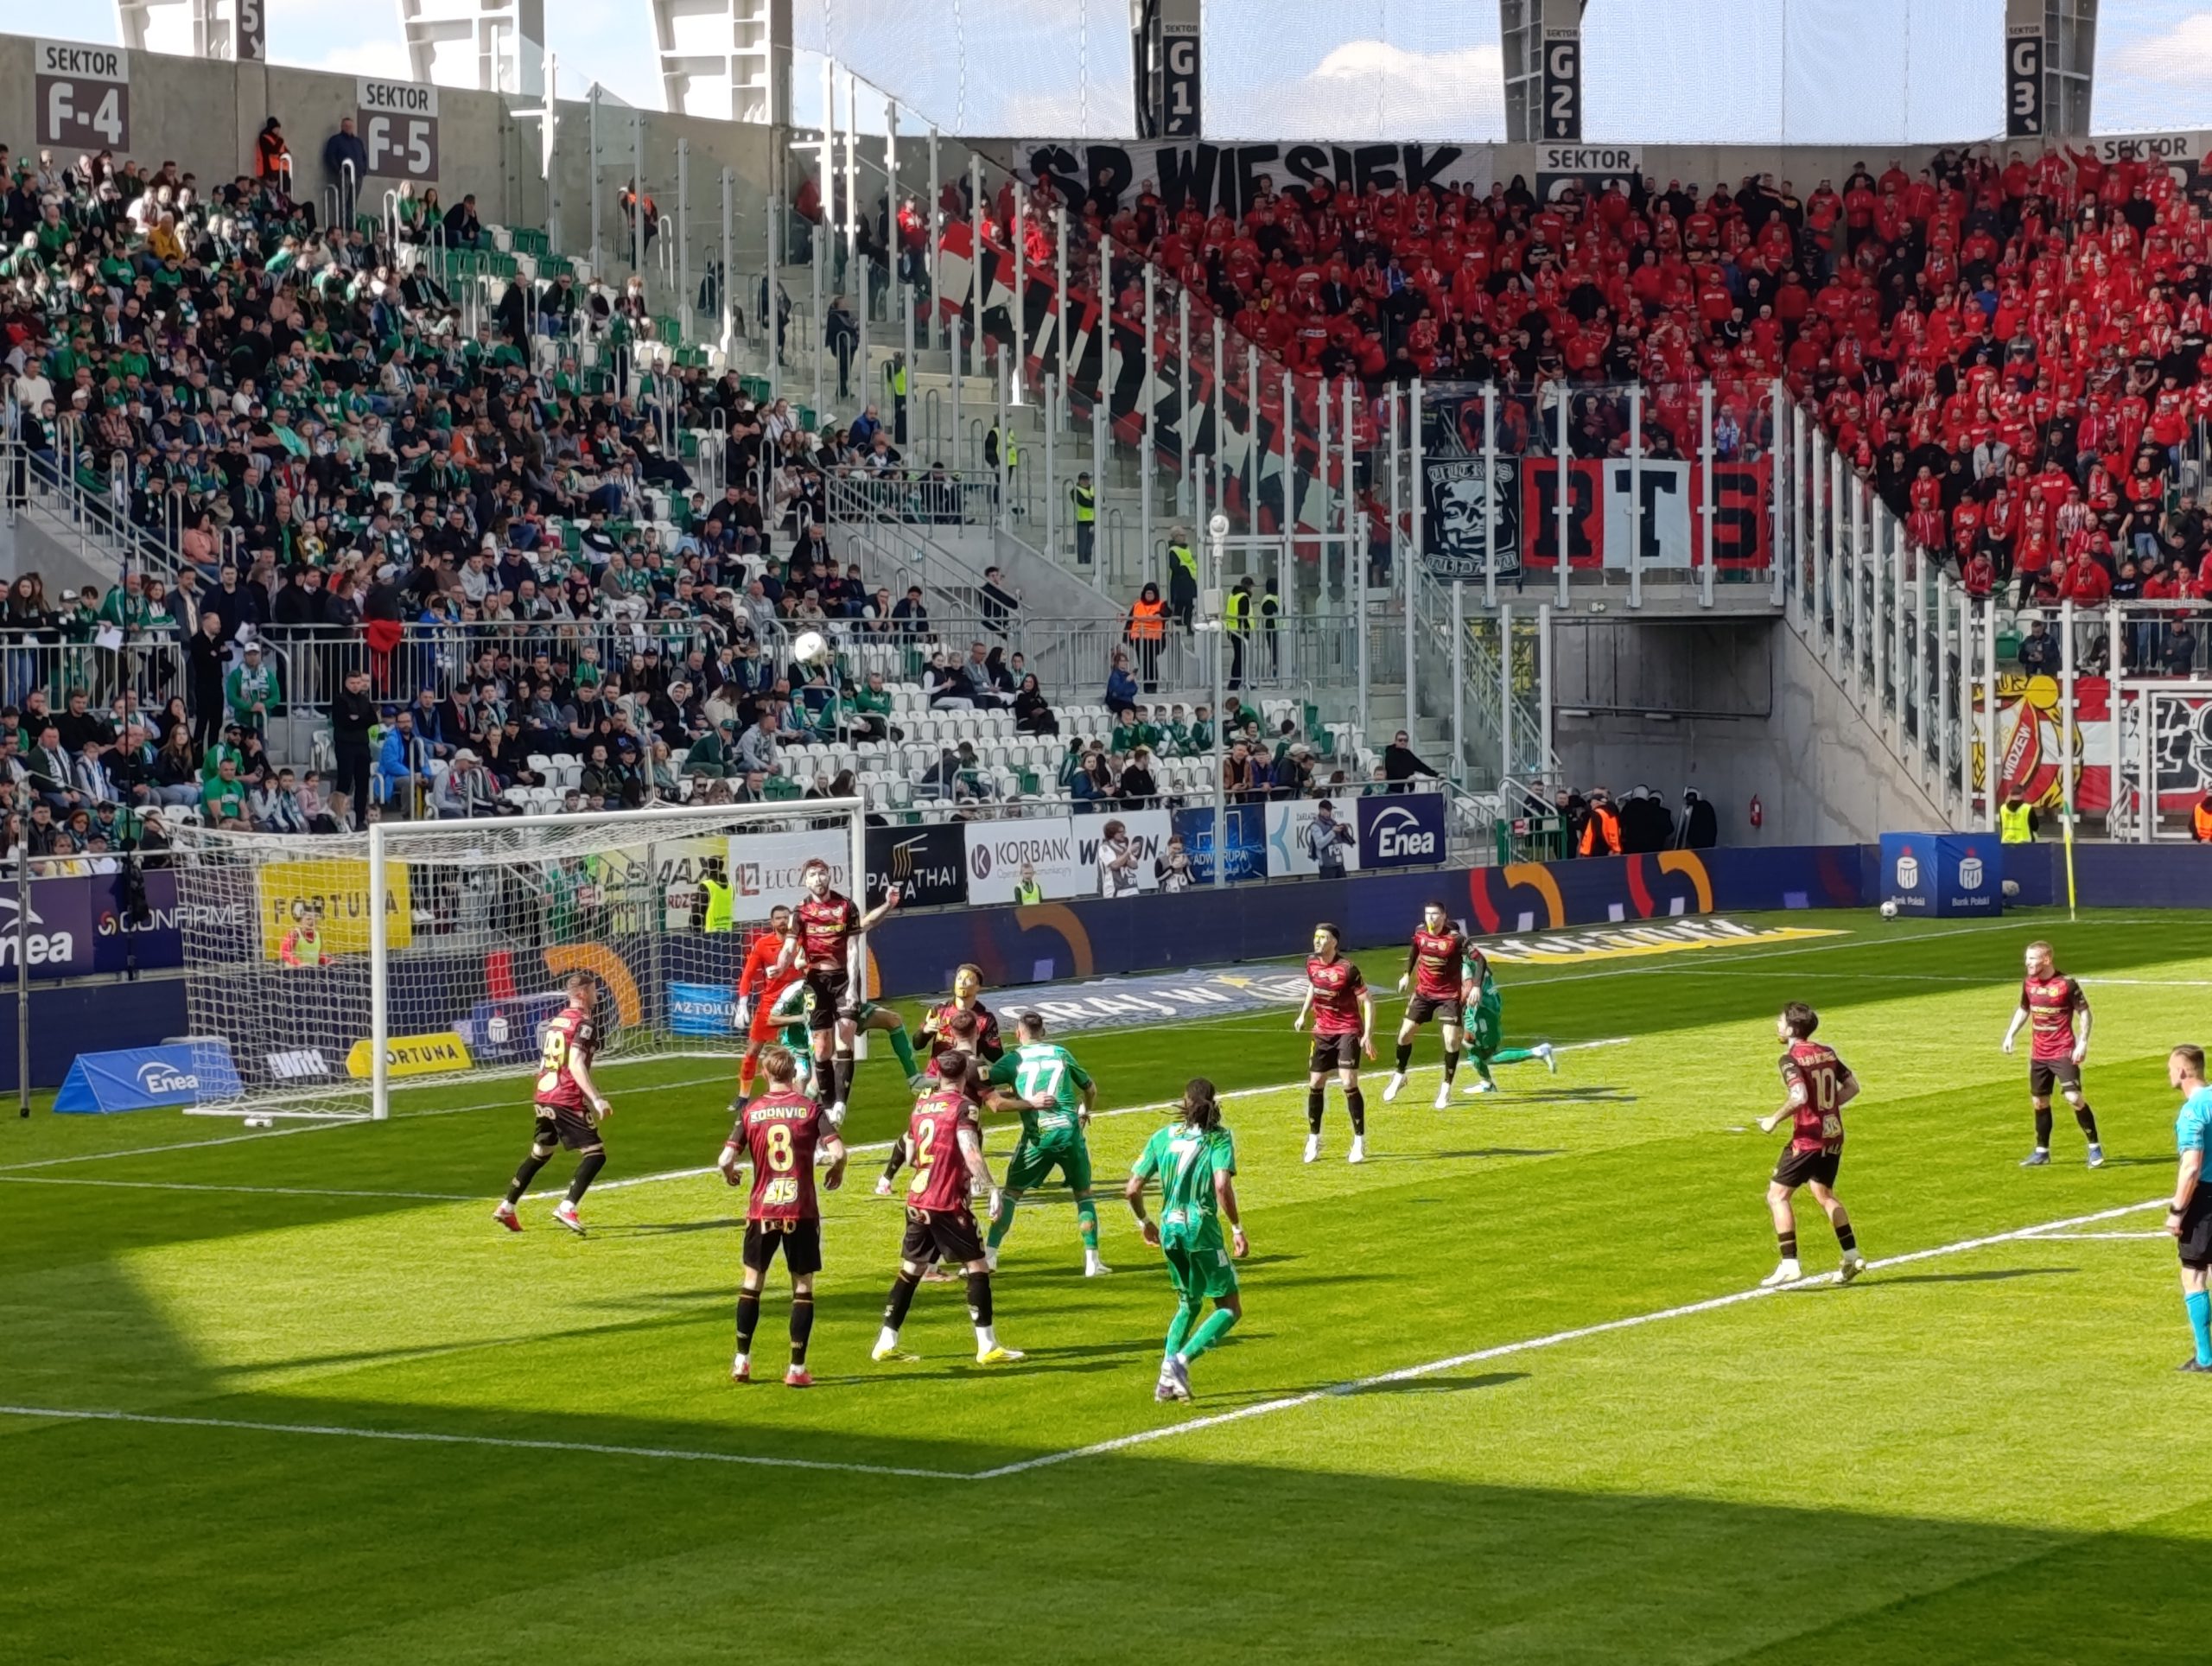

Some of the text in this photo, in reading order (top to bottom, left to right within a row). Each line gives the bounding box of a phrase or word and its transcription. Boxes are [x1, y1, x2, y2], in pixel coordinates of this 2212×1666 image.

[1165, 24, 1198, 33] SEKTOR
[47, 47, 118, 76] SEKTOR
[366, 83, 428, 111] SEKTOR
[48, 81, 122, 145] F-4
[368, 116, 430, 174] F-5
[1548, 149, 1630, 169] SEKTOR
[1427, 461, 1514, 483] ULTRS
[2003, 721, 2031, 781] WIDZEW
[995, 838, 1071, 864] KORBANK
[1379, 827, 1434, 857] Enea
[766, 865, 843, 889] ŁUCZD
[0, 932, 73, 966] nea
[1149, 987, 1236, 1004] W
[387, 1044, 459, 1066] ORTUNA
[146, 1073, 199, 1094] Enea
[1018, 1060, 1064, 1100] 77
[1811, 1068, 1835, 1111] 10
[767, 1124, 794, 1172] 8
[918, 1118, 935, 1166] 2
[1170, 1139, 1201, 1176] 7
